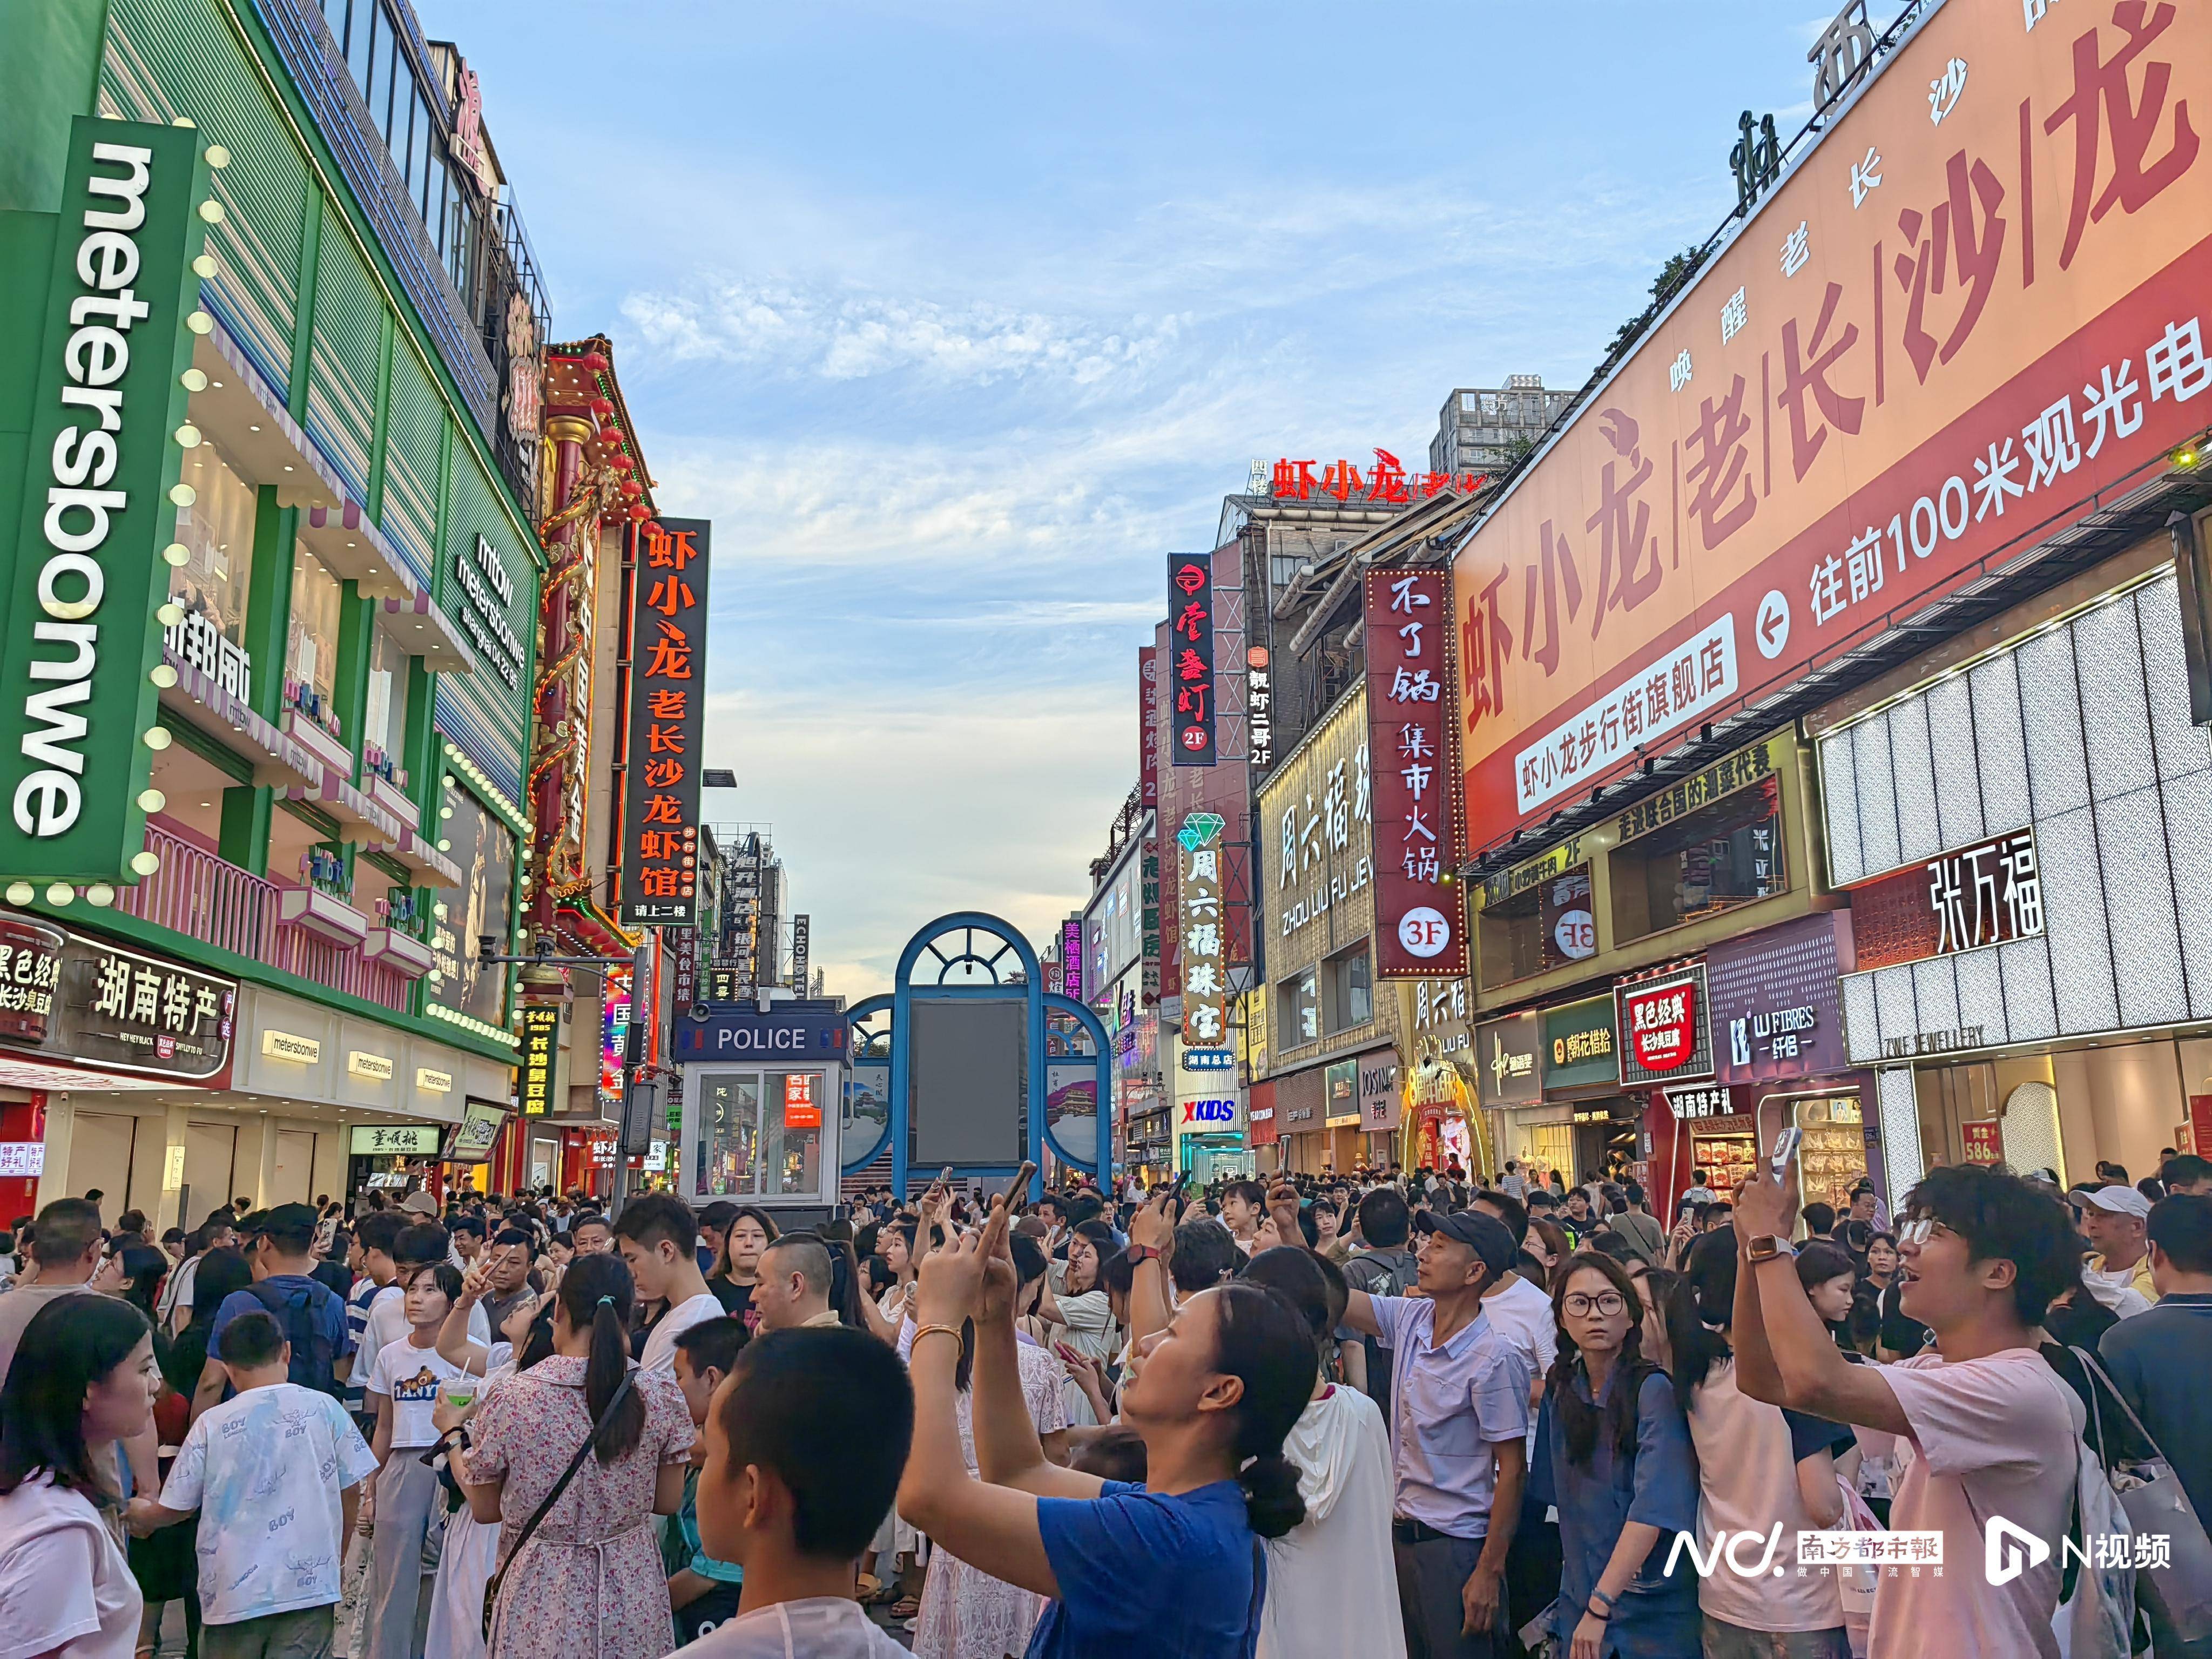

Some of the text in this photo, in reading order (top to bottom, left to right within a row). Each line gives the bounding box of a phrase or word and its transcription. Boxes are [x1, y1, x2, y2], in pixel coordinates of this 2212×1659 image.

[13, 141, 152, 837] metersbonwe
[1251, 458, 1267, 495] 四楼
[477, 532, 514, 609] mtbw
[457, 555, 525, 670] metersbonwe
[645, 529, 698, 679] 虾小龙
[461, 607, 518, 693] shanghai 04 22 95
[1387, 576, 1441, 703] 不了锅
[1249, 671, 1271, 764] 靓虾二哥 2F
[1521, 635, 1725, 800] 虾小龙步行街旗舰店
[1184, 732, 1205, 745] 2F
[639, 688, 686, 899] 老长沙龙虾馆
[1398, 723, 1440, 885] 集市火锅
[682, 827, 696, 897] 步行街二店
[1564, 837, 1581, 868] 2F
[1282, 897, 1309, 937] ZHOU
[1312, 882, 1329, 917] LIU
[1331, 870, 1347, 906] FU
[1927, 834, 2046, 955] 张万福
[634, 904, 686, 920] 请上二楼
[1187, 849, 1223, 1039] 周六福珠宝
[1406, 920, 1444, 947] 3F
[1064, 922, 1081, 988] 美栖酒店
[95, 954, 217, 1036] 湖南特产
[715, 974, 730, 1001] 四喜
[1634, 993, 1685, 1031] 黑色经典
[120, 1032, 129, 1042] HEY
[130, 1034, 139, 1043] HEY
[274, 1036, 318, 1058] metersbonwe
[718, 1028, 806, 1049] POLICE
[1641, 1028, 1681, 1053] 长沙臭豆腐
[357, 1056, 392, 1075] metersbonwe
[525, 1036, 549, 1115] 长沙臭豆腐
[1188, 1055, 1233, 1066] 湖南总店
[424, 1073, 451, 1088] metersbonwe
[1180, 1100, 1235, 1125] XKIDS
[1673, 1087, 1734, 1120] 湖南特产礼
[0, 1157, 24, 1168] 好礼
[2, 1146, 26, 1157] 特产
[1966, 1142, 1991, 1161] 586
[221, 1417, 246, 1434] BOY
[285, 1424, 307, 1439] BOY
[269, 1506, 295, 1532] BOY
